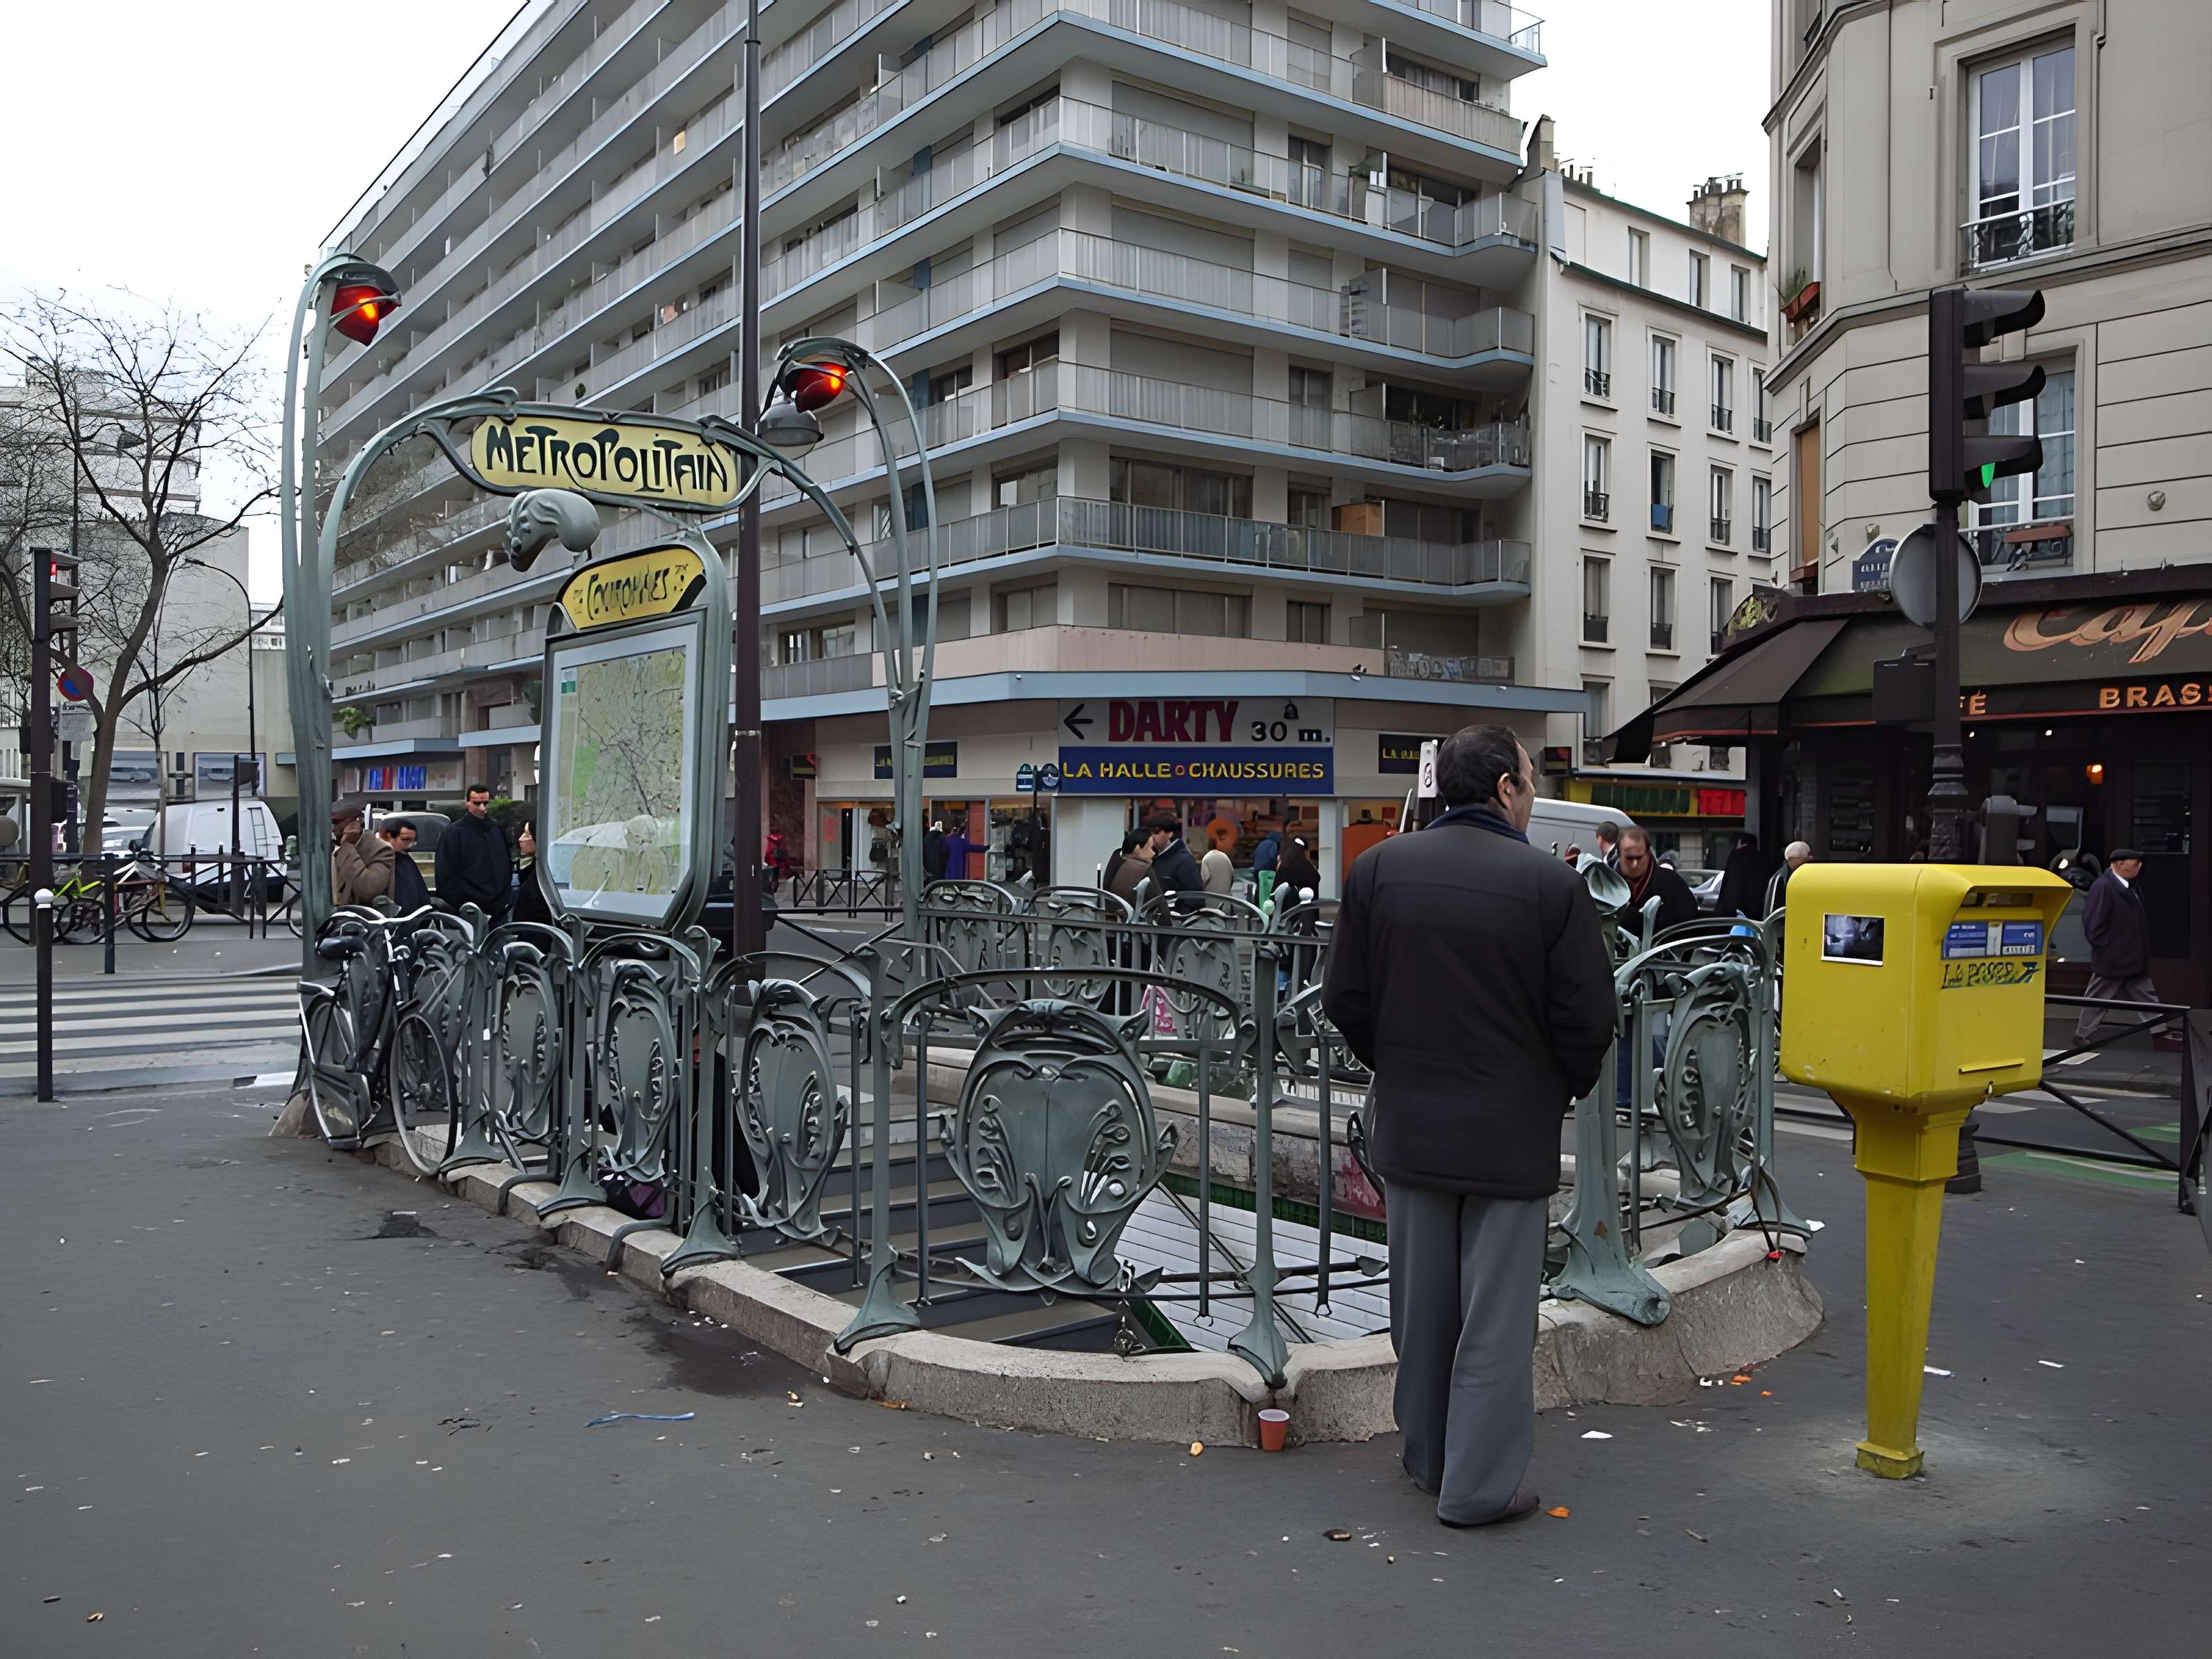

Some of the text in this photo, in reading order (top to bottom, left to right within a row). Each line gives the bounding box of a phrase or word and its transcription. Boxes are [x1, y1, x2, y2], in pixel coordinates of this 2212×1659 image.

[486, 424, 728, 496] METROPOLITAIN
[2003, 600, 2212, 664] Caf
[1107, 700, 1239, 743] DARTY
[1251, 720, 1288, 742] 30
[1062, 762, 1093, 778] LA
[1100, 762, 1172, 779] HALLE
[1188, 762, 1324, 778] CHAUSSURES
